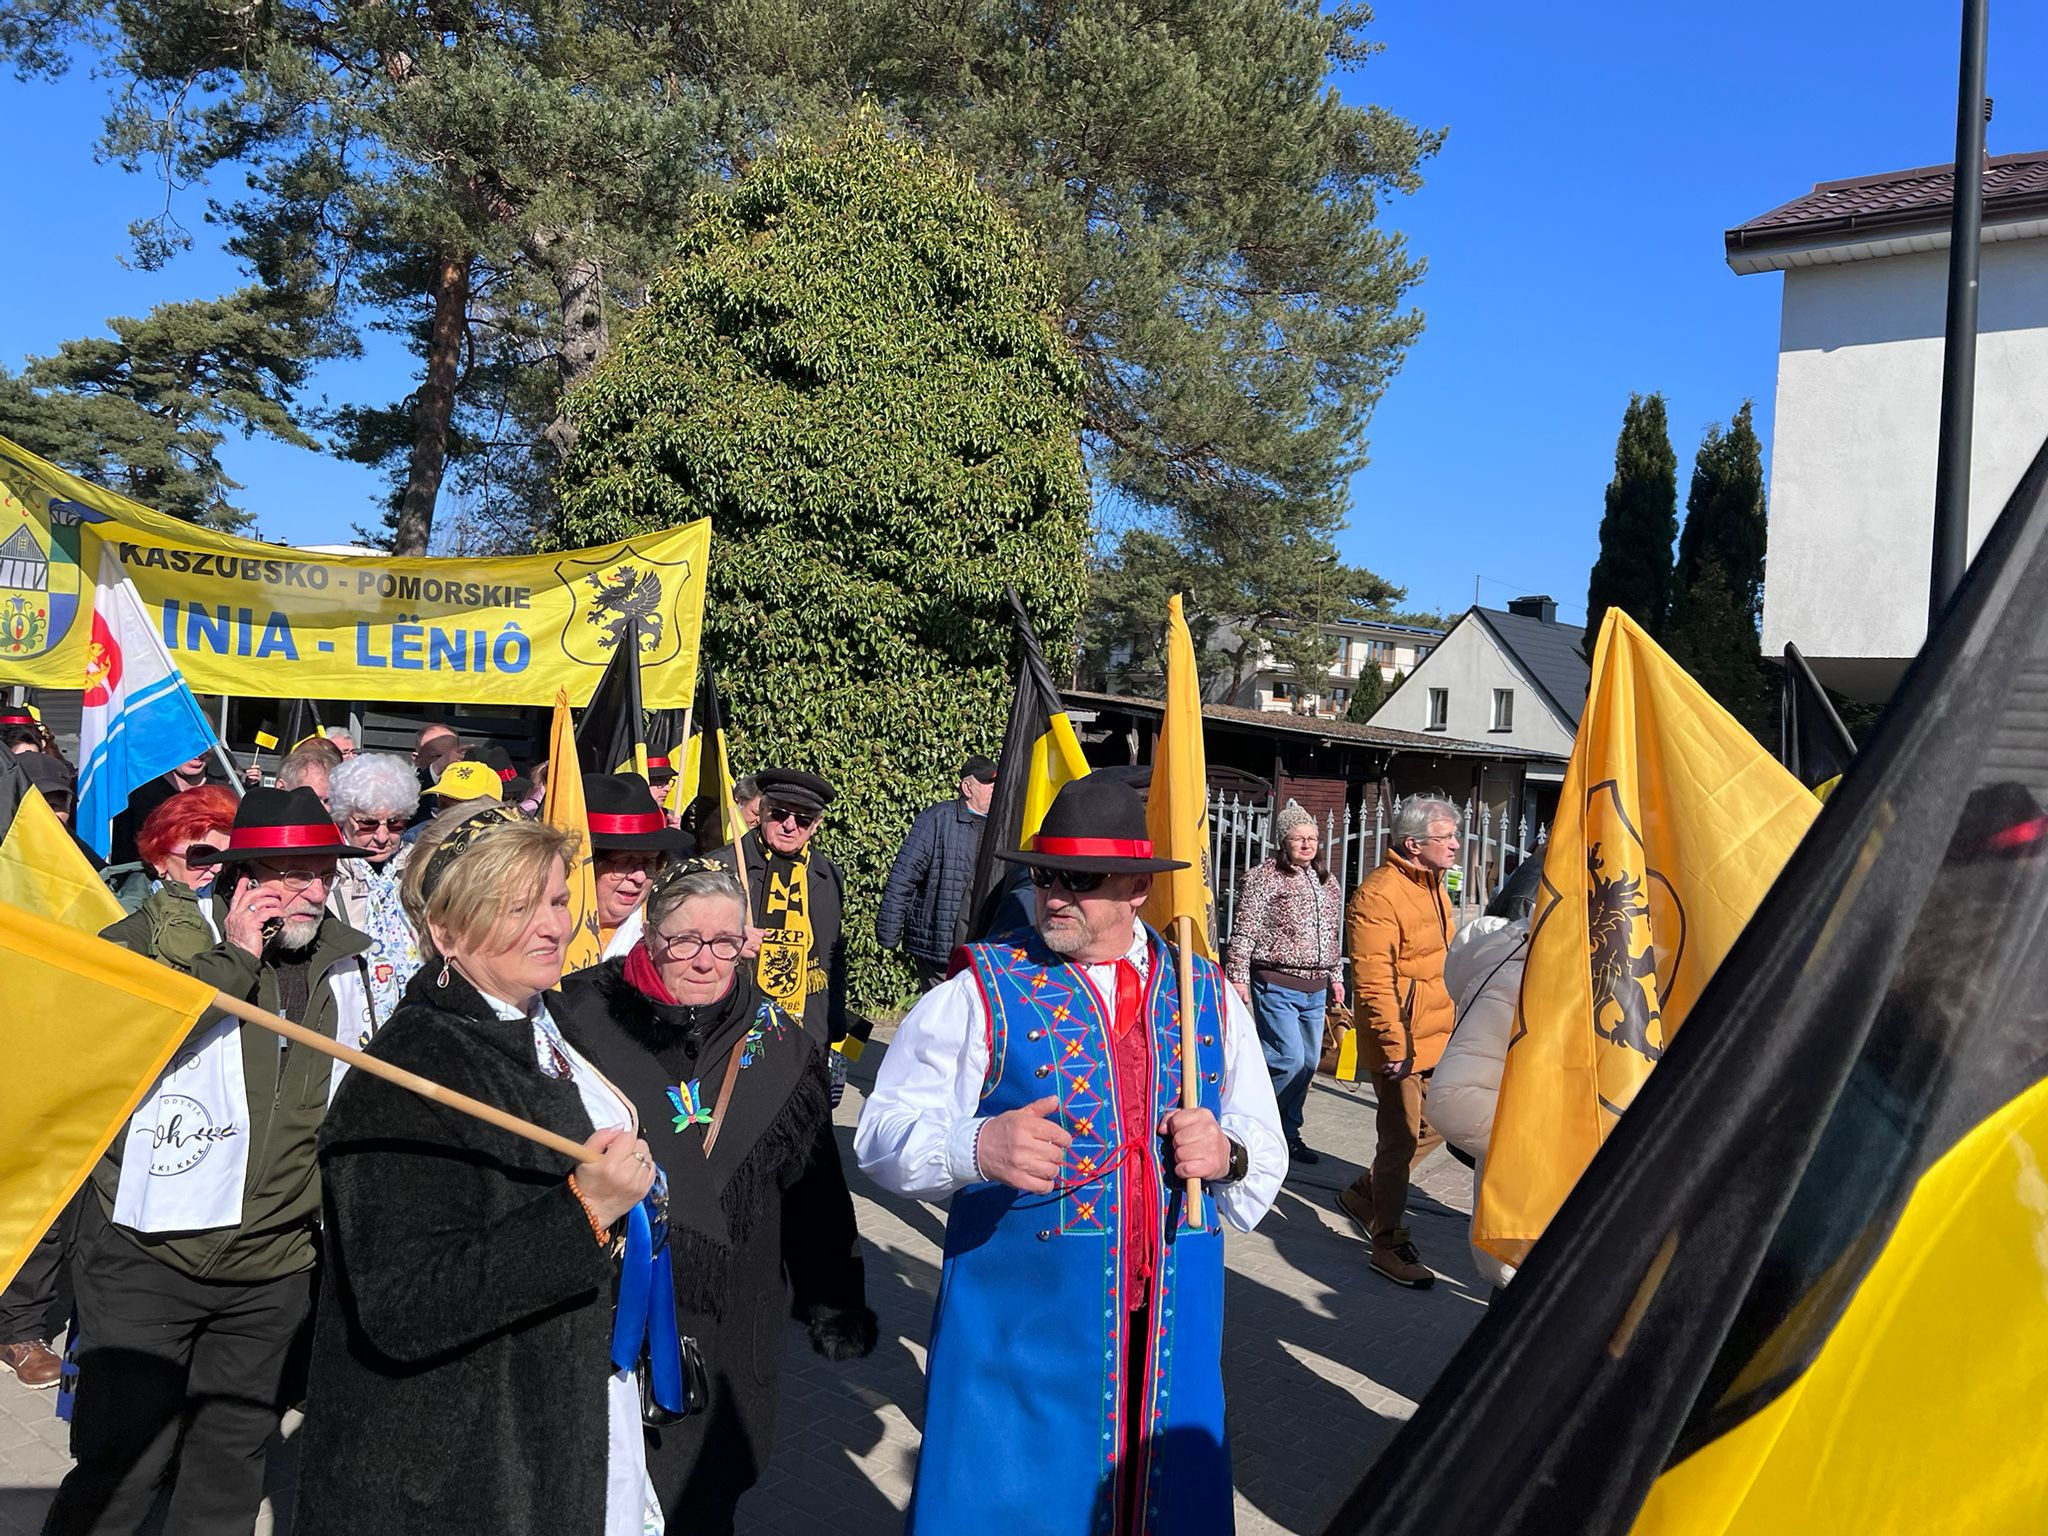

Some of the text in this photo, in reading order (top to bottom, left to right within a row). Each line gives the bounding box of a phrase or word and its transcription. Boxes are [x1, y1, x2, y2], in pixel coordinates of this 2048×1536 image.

[118, 541, 329, 590] KASZUBSKO
[357, 571, 531, 609] POMORSKIE
[163, 598, 531, 674] INIA - LËNIÔ
[778, 1000, 801, 1011] ËBË
[151, 1148, 205, 1172] LKI KACK
